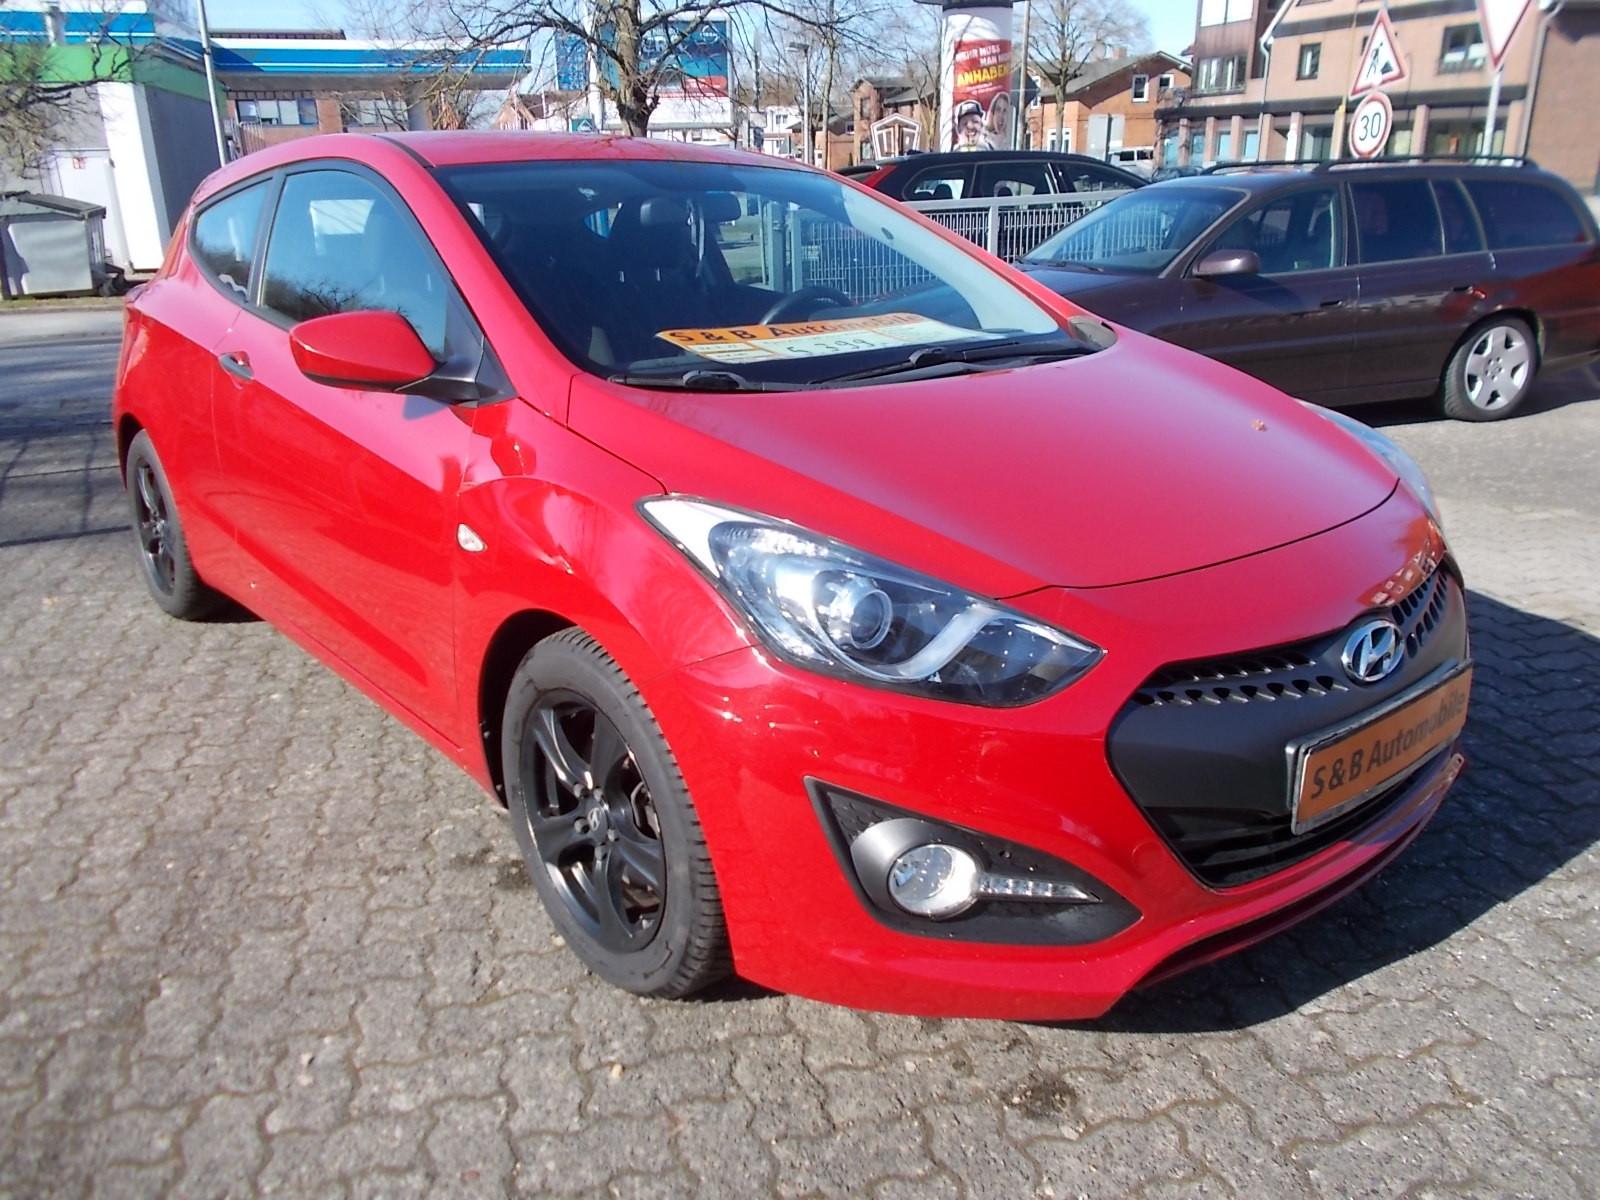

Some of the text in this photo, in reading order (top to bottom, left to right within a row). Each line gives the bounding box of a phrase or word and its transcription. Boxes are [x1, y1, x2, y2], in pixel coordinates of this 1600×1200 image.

[1359, 112, 1382, 141] 30
[669, 332, 695, 342] S
[700, 331, 728, 342] &
[728, 329, 758, 341] B
[1366, 689, 1466, 774] Automobile
